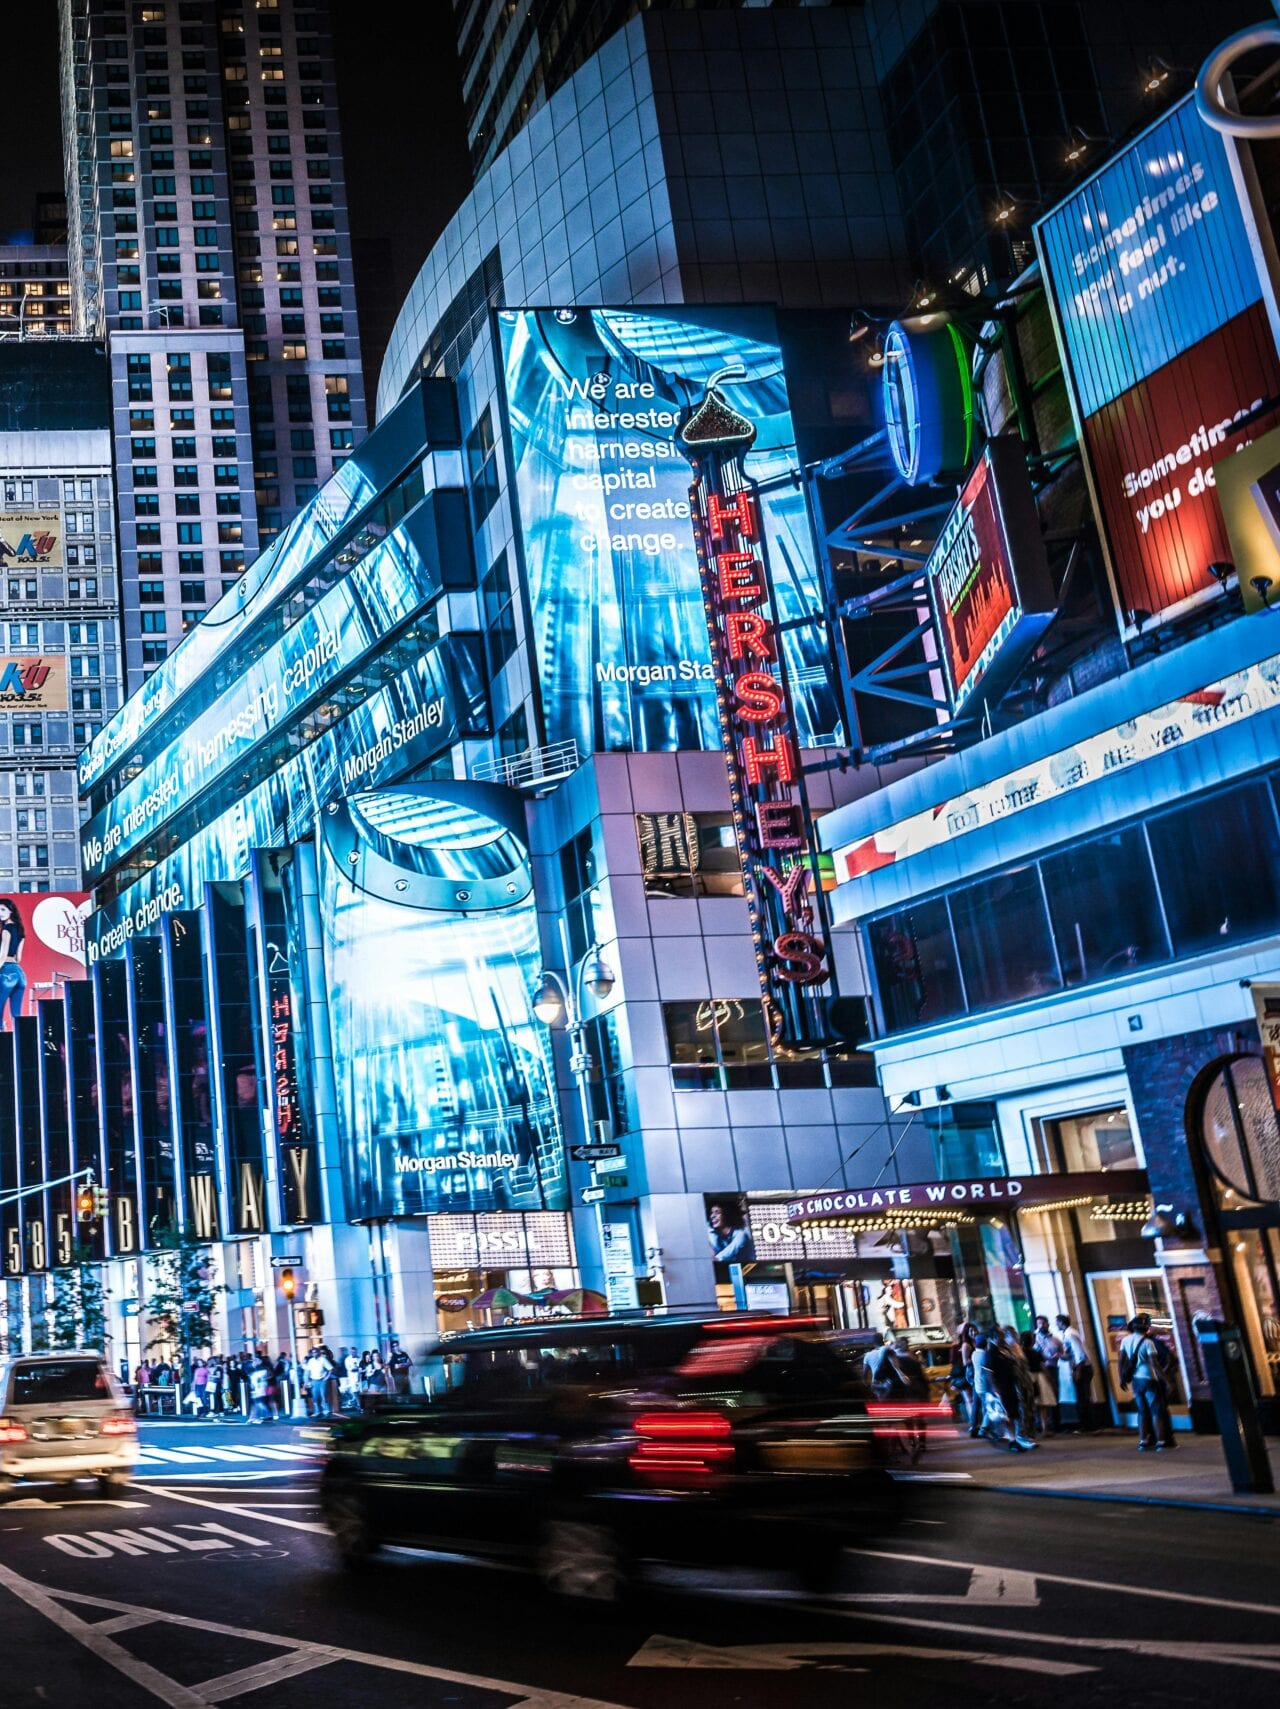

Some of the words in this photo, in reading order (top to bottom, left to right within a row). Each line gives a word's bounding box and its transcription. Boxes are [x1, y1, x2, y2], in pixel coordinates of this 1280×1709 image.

[1072, 162, 1204, 276] Sometimes
[1075, 269, 1115, 315] you
[1119, 223, 1166, 276] feel
[1170, 191, 1218, 237] like
[1119, 292, 1133, 314] a
[1138, 255, 1186, 300] nut.
[561, 377, 607, 400] We
[615, 381, 655, 399] are
[568, 436, 681, 461] harnessi
[572, 467, 656, 497] capital
[576, 502, 600, 522] to
[610, 498, 690, 521] create
[1136, 487, 1182, 534] you
[580, 530, 683, 556] change.
[596, 663, 677, 685] Morgan
[83, 837, 103, 870] We
[103, 822, 121, 854] are
[121, 772, 181, 838] interested
[182, 752, 196, 787] in
[197, 681, 280, 770] harnessing
[282, 622, 344, 697] capital
[344, 738, 393, 785] Morgan
[392, 695, 446, 750] Stanley
[87, 940, 100, 967] to
[101, 916, 134, 957] create
[135, 883, 184, 933] change.
[394, 1155, 457, 1175] Morgan
[458, 1150, 520, 1172] Stanley
[807, 1189, 912, 1214] CHOCOLATE
[926, 1181, 1023, 1201] WORLD
[456, 1231, 541, 1252] FOSSIL
[42, 1522, 273, 1558] ONLY
